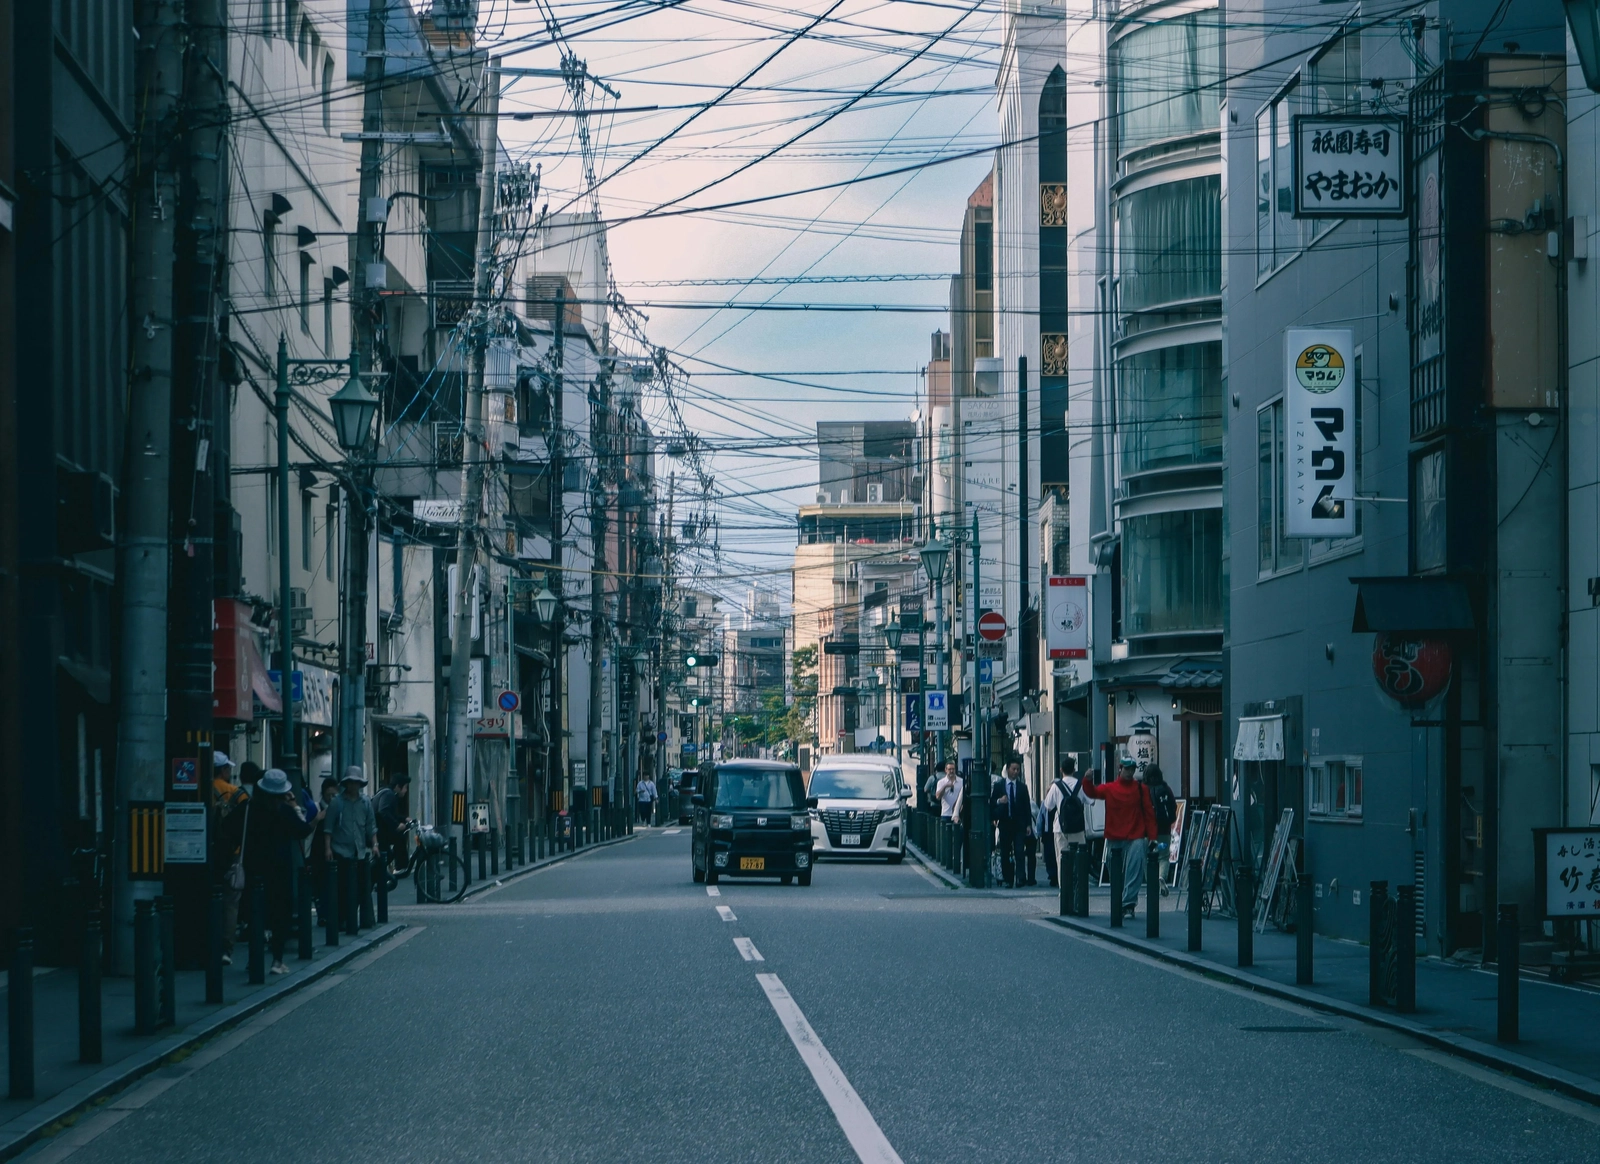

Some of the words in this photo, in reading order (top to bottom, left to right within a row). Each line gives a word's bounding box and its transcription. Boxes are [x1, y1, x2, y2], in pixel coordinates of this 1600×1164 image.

[1304, 169, 1399, 202] やまおか
[1304, 370, 1337, 382] マウム
[967, 401, 1000, 410] SAKIZO
[1295, 421, 1304, 505] IZAKAYA
[1310, 407, 1345, 519] マウム
[476, 717, 505, 729] くすり
